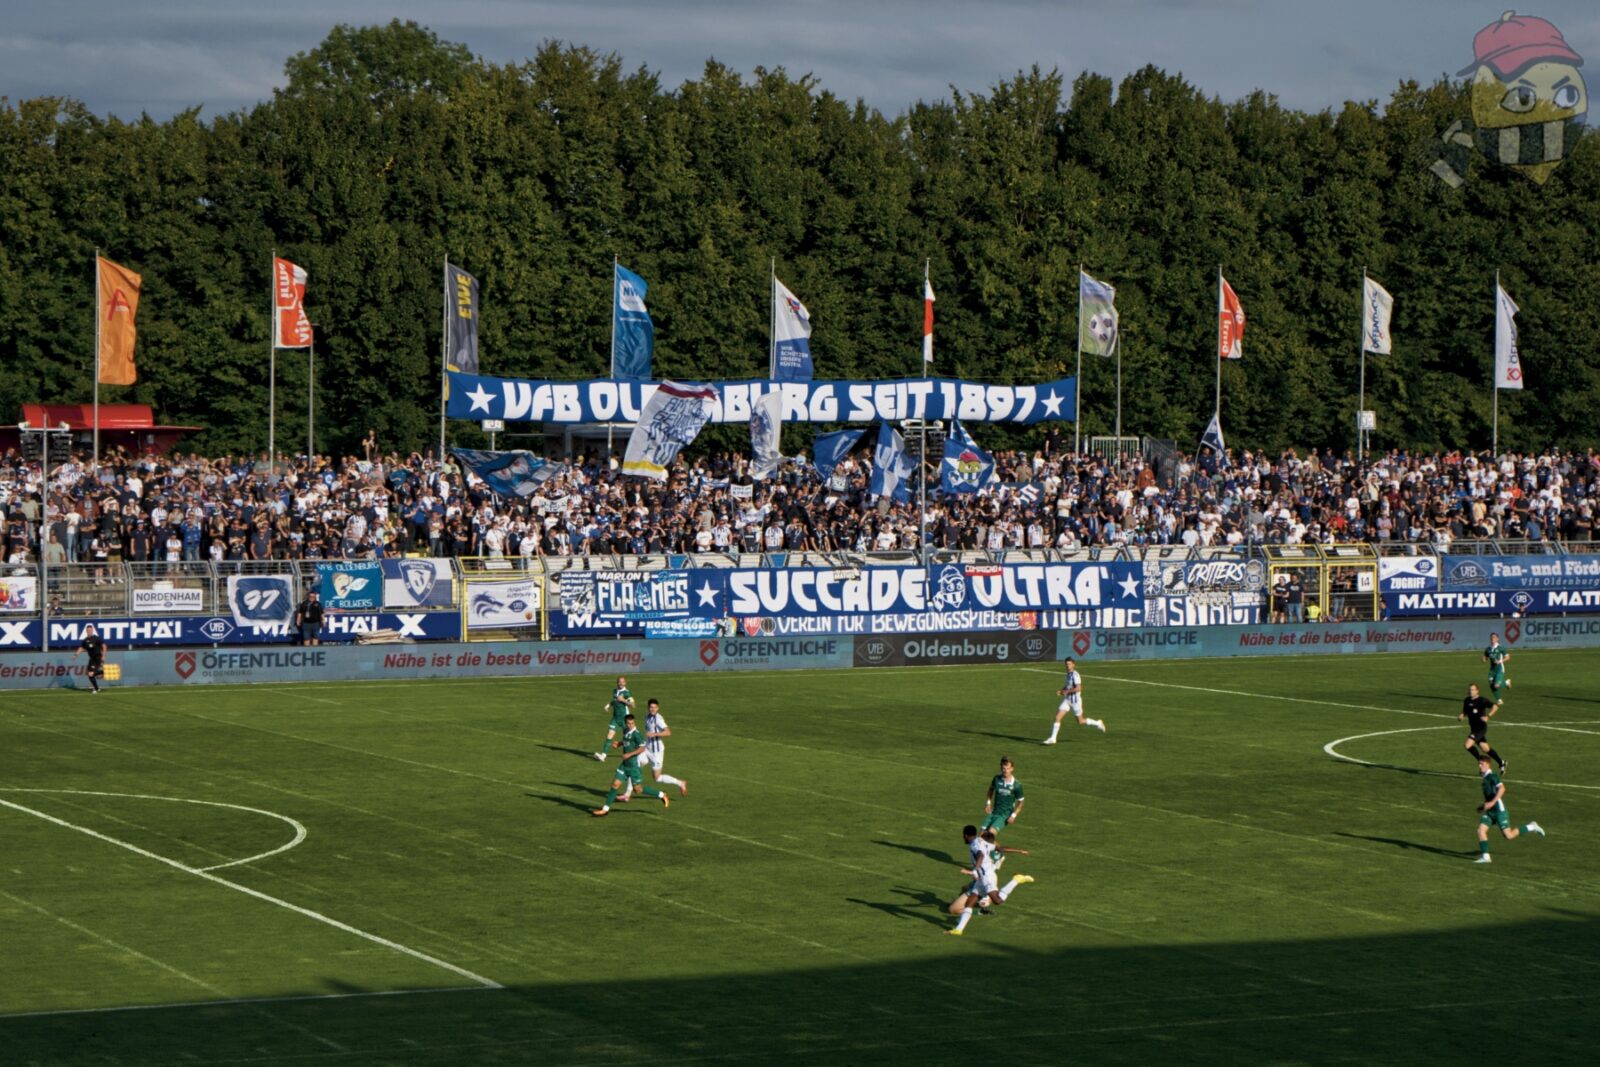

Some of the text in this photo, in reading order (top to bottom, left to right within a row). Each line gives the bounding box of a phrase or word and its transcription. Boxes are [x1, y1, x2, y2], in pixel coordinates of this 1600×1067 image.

[456, 273, 472, 320] EWE
[848, 381, 934, 422] SEIT
[940, 382, 1037, 422] 1897
[335, 562, 380, 571] OLDENBURG
[1493, 562, 1528, 577] Fan-
[1531, 561, 1562, 576] und
[596, 572, 642, 581] MARLON
[1361, 578, 1370, 587] 14
[1390, 577, 1426, 590] ZUGRIFF
[1521, 576, 1600, 587] VfB Oldenburg
[136, 592, 200, 602] NORDENHAM
[244, 589, 280, 611] 97
[730, 569, 926, 613] SUCCADE
[1399, 593, 1496, 609] MATTHÄI
[396, 614, 427, 637] X
[1095, 631, 1197, 647] ÖFFENTLICHE
[1239, 628, 1455, 646] Nähe ist die beste Versicherung.
[724, 639, 836, 657] ÖFFENTLICHE
[904, 638, 1008, 660] Oldenburg
[202, 651, 326, 669] ÖFFENTLICHE
[384, 649, 646, 668] Nähe ist die beste Versicherung.
